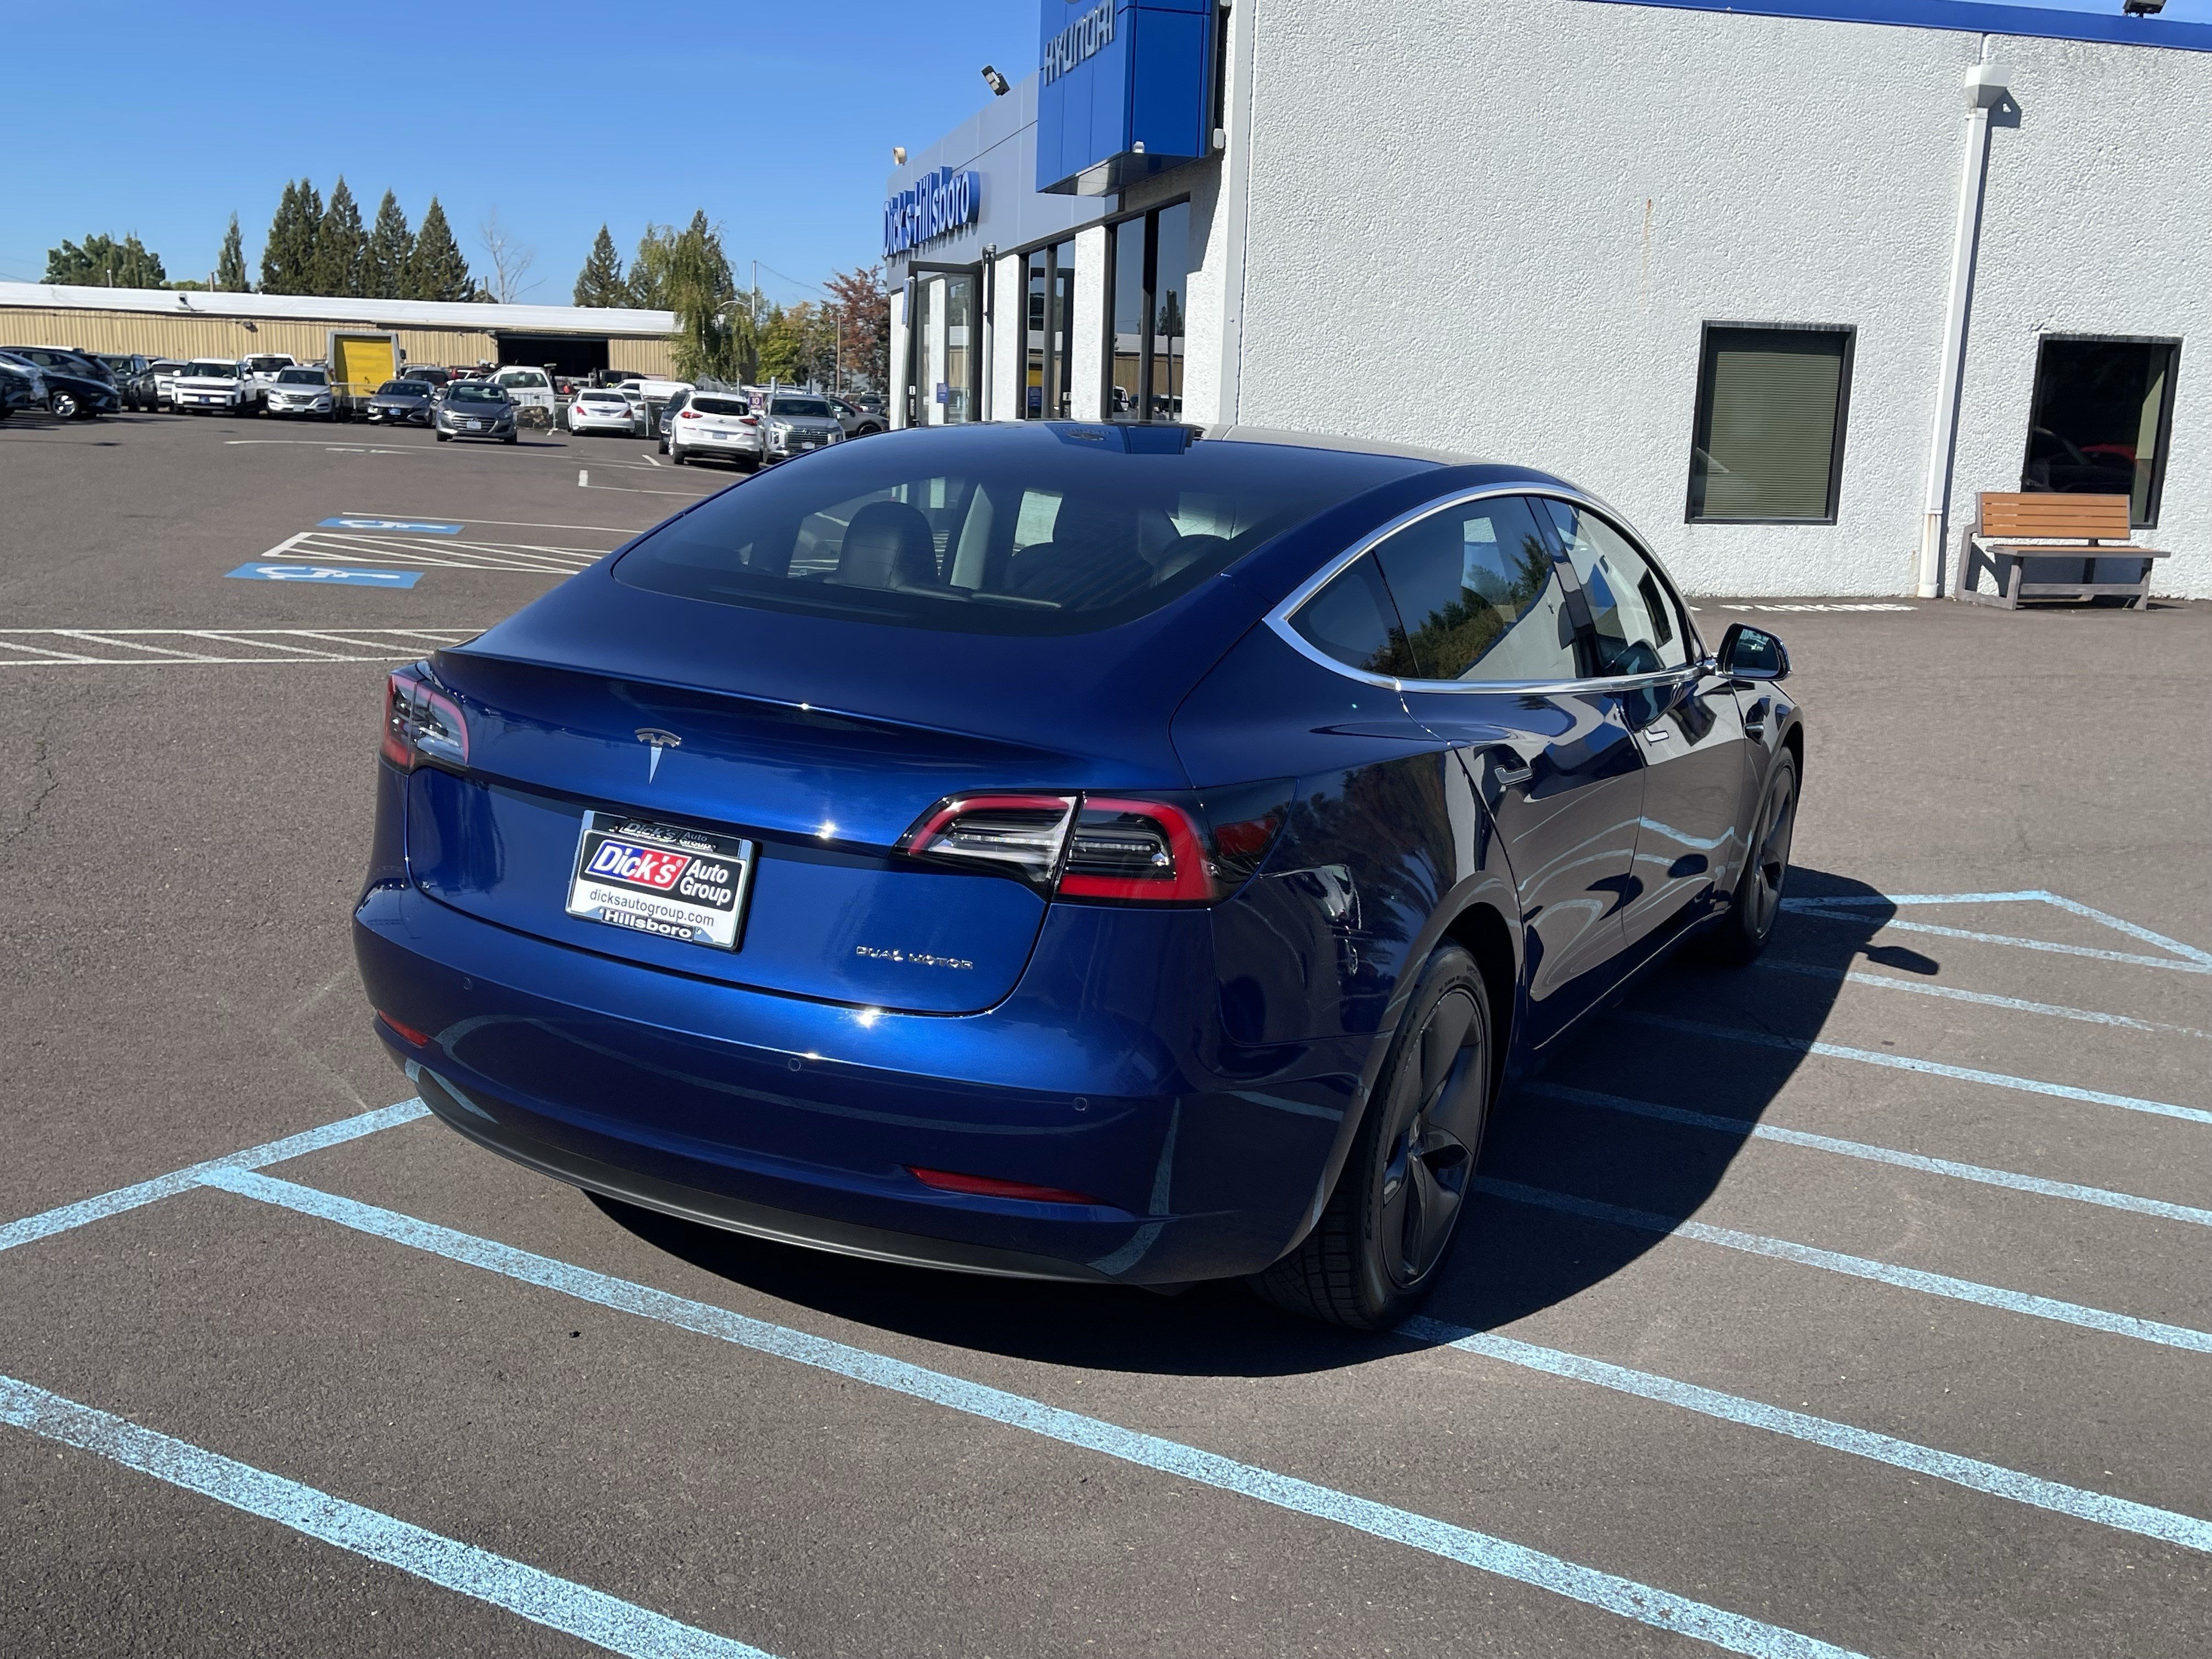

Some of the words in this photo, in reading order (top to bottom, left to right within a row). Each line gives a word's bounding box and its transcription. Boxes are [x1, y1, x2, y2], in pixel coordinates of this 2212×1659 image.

[1044, 0, 1115, 86] HYUNDAI
[883, 190, 915, 257] Dick's
[914, 166, 980, 244] Hillsboro
[683, 831, 708, 842] Auto
[593, 845, 678, 888] Dick's
[685, 859, 729, 883] Auto
[590, 889, 714, 927] dicksautogroup.com
[679, 876, 732, 906] Group
[604, 909, 692, 938] Hillsboro
[856, 946, 904, 961] DUAL
[909, 953, 973, 969] MOTOR
